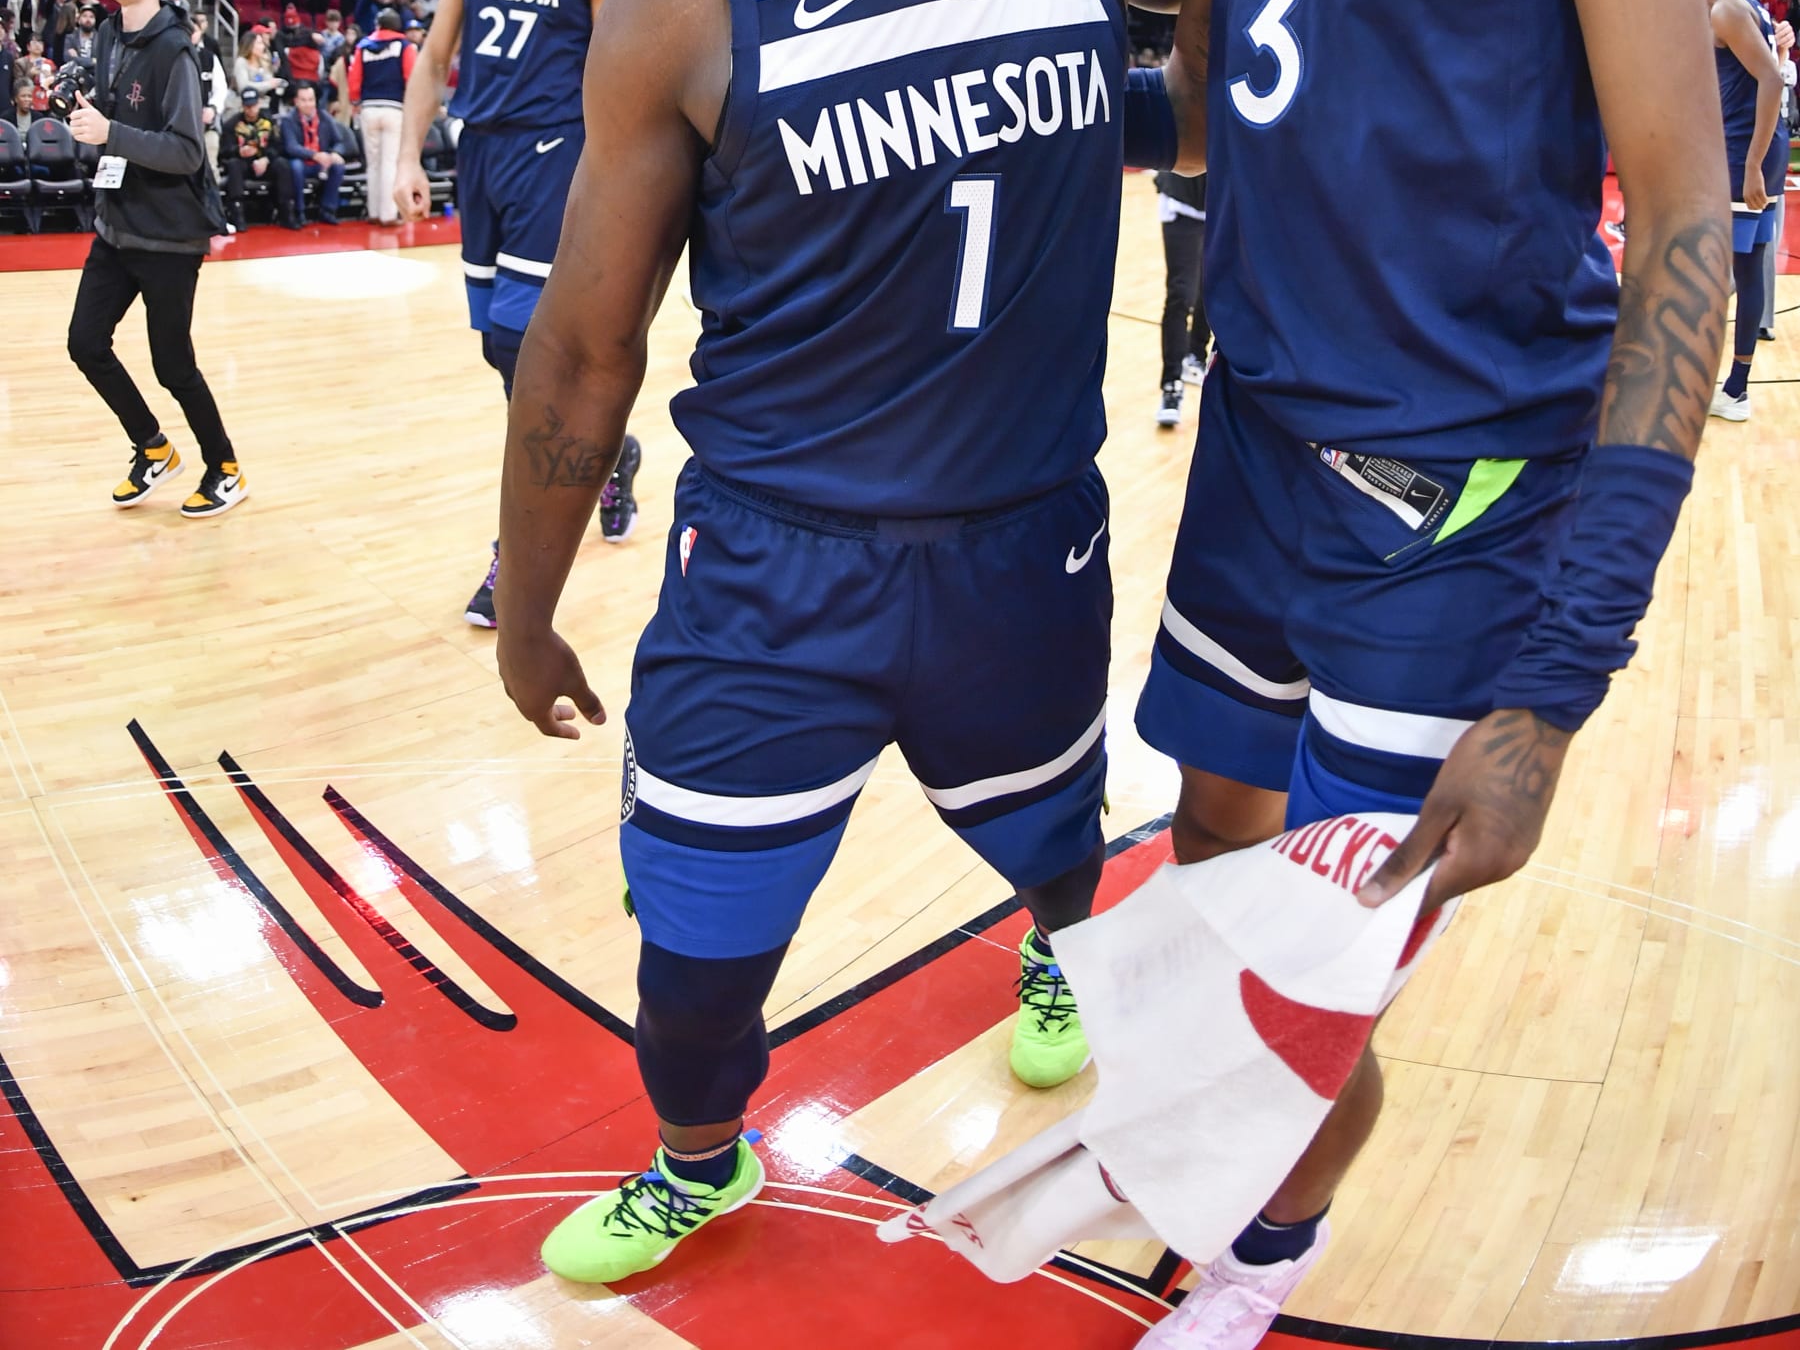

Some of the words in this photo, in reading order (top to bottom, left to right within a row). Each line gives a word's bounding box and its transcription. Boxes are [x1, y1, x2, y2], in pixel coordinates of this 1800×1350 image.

[474, 6, 539, 60] 27
[777, 48, 1110, 196] MINNESOTA
[946, 175, 1000, 332] 1
